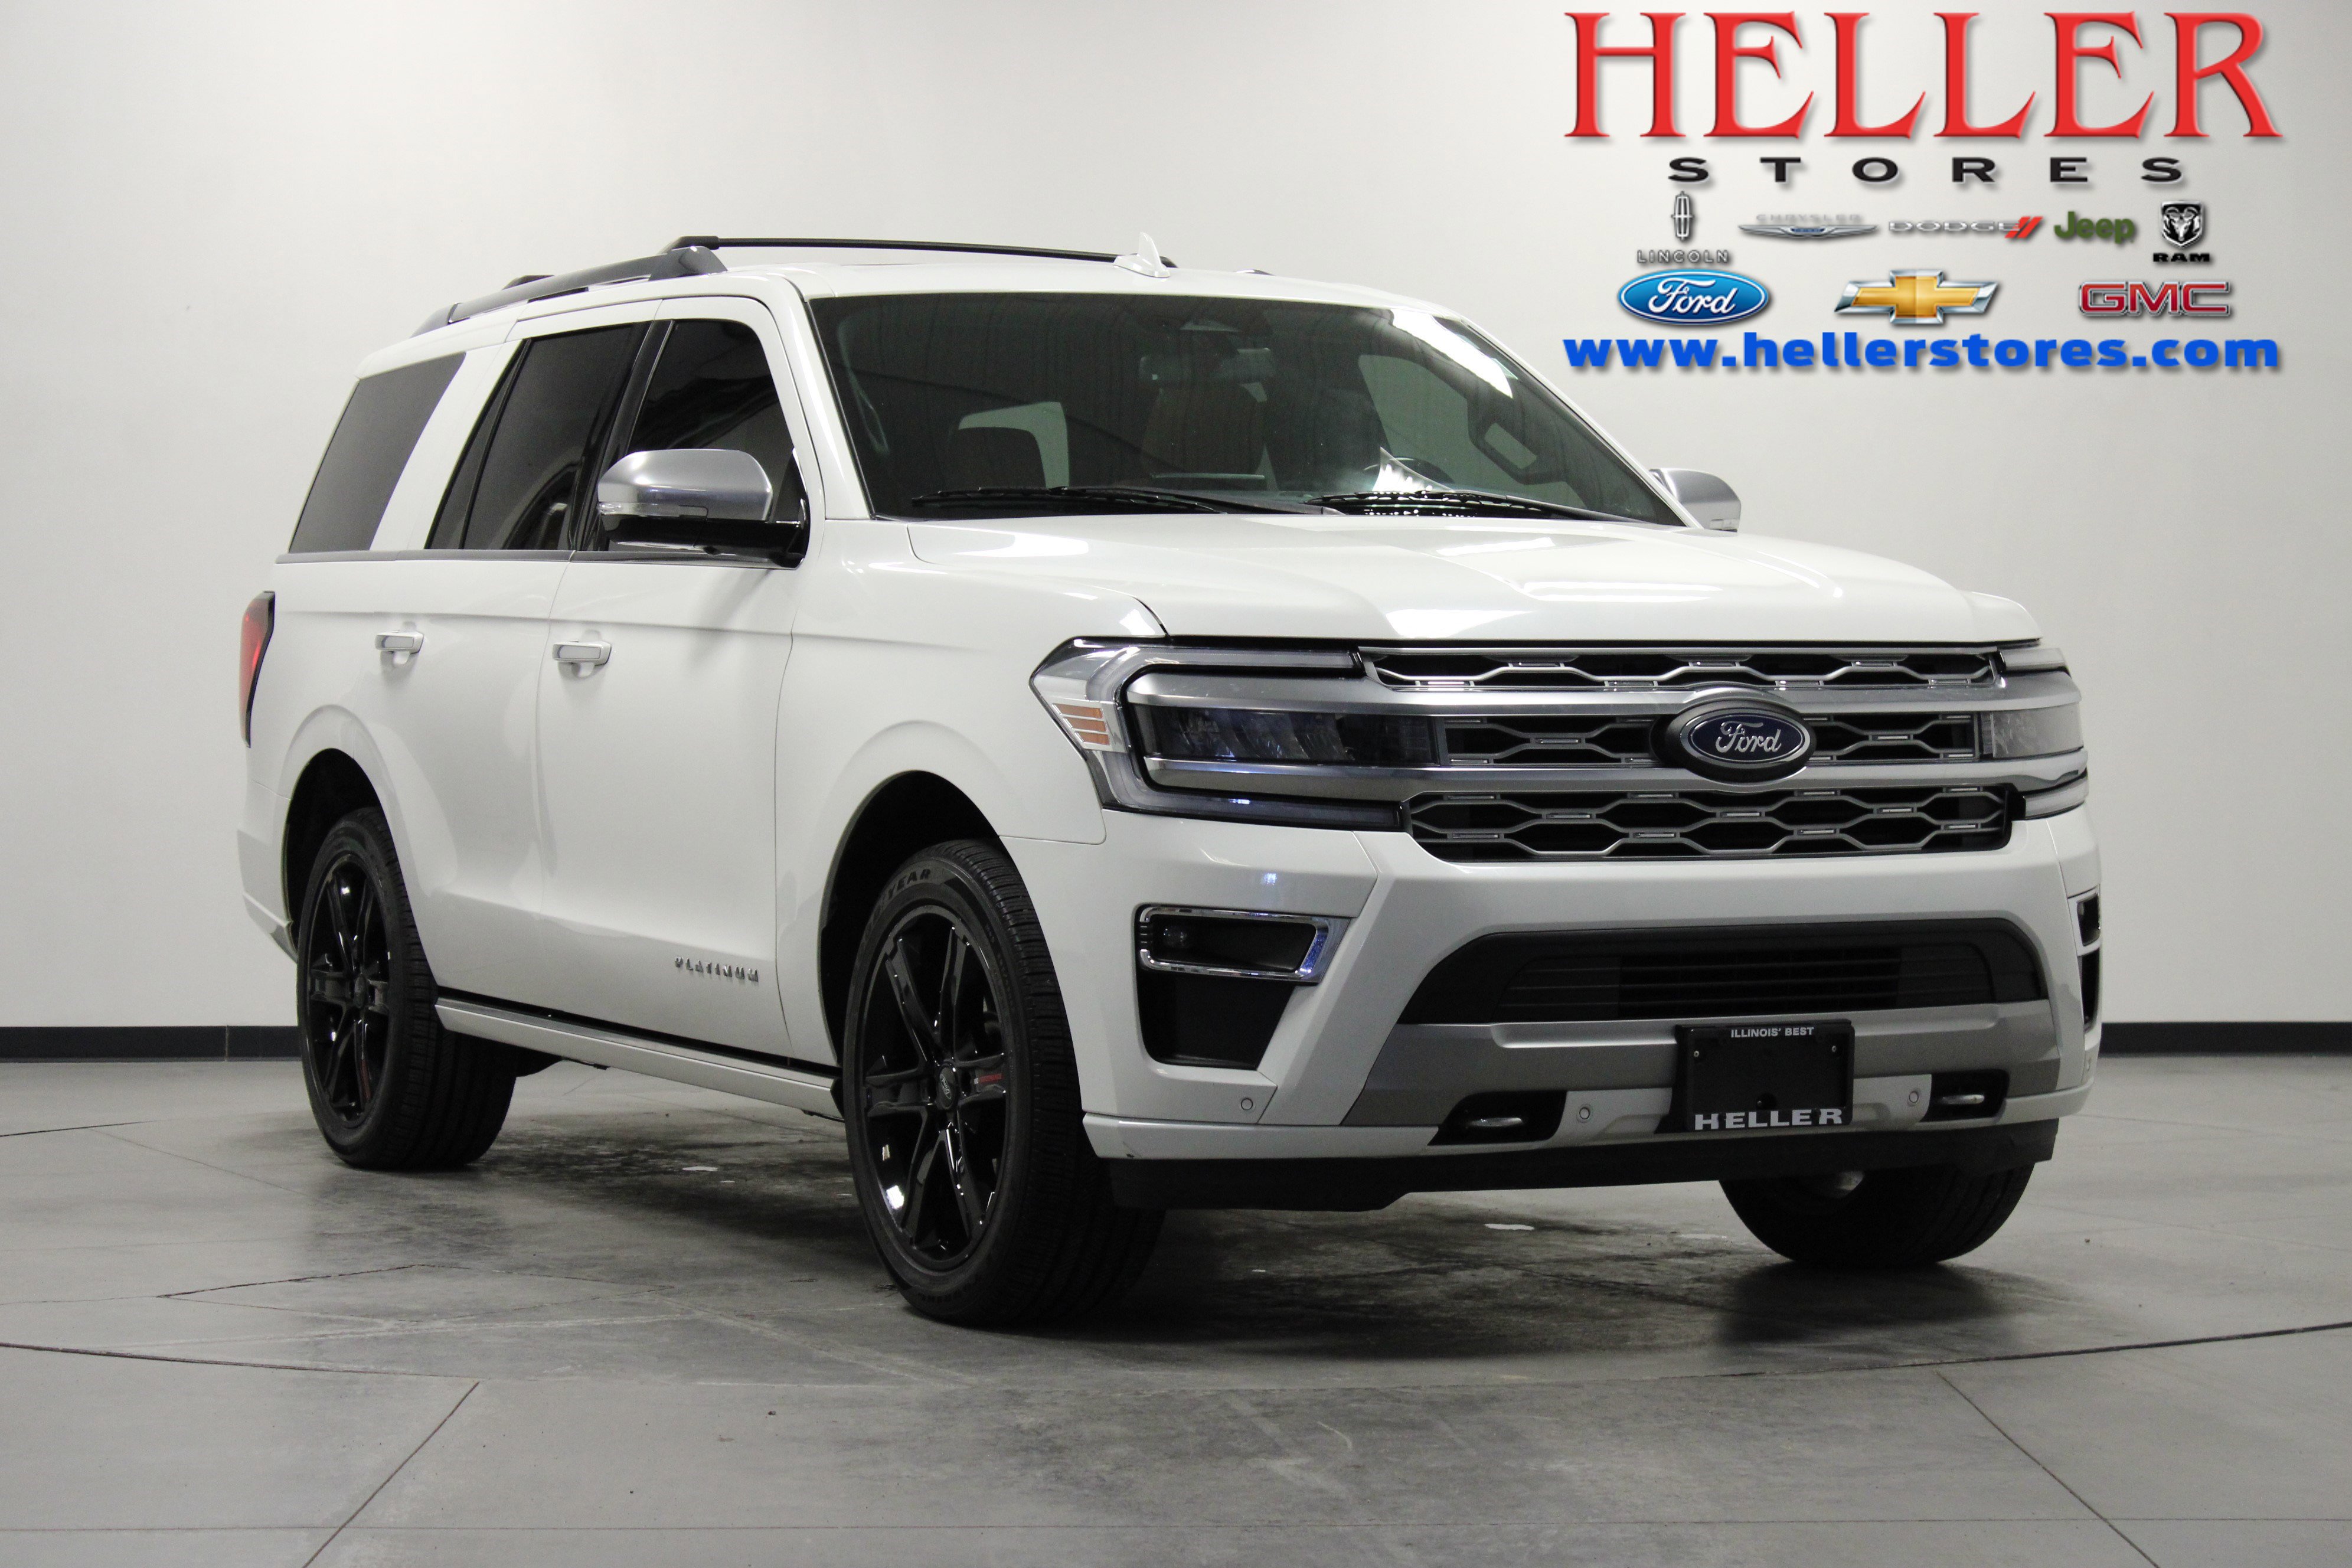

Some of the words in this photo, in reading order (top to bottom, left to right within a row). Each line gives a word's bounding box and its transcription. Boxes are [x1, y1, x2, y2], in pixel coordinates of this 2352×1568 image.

[1715, 721, 1782, 753] Ford
[1785, 1026, 1815, 1036] BEST
[1694, 1108, 1842, 1131] HELLER
